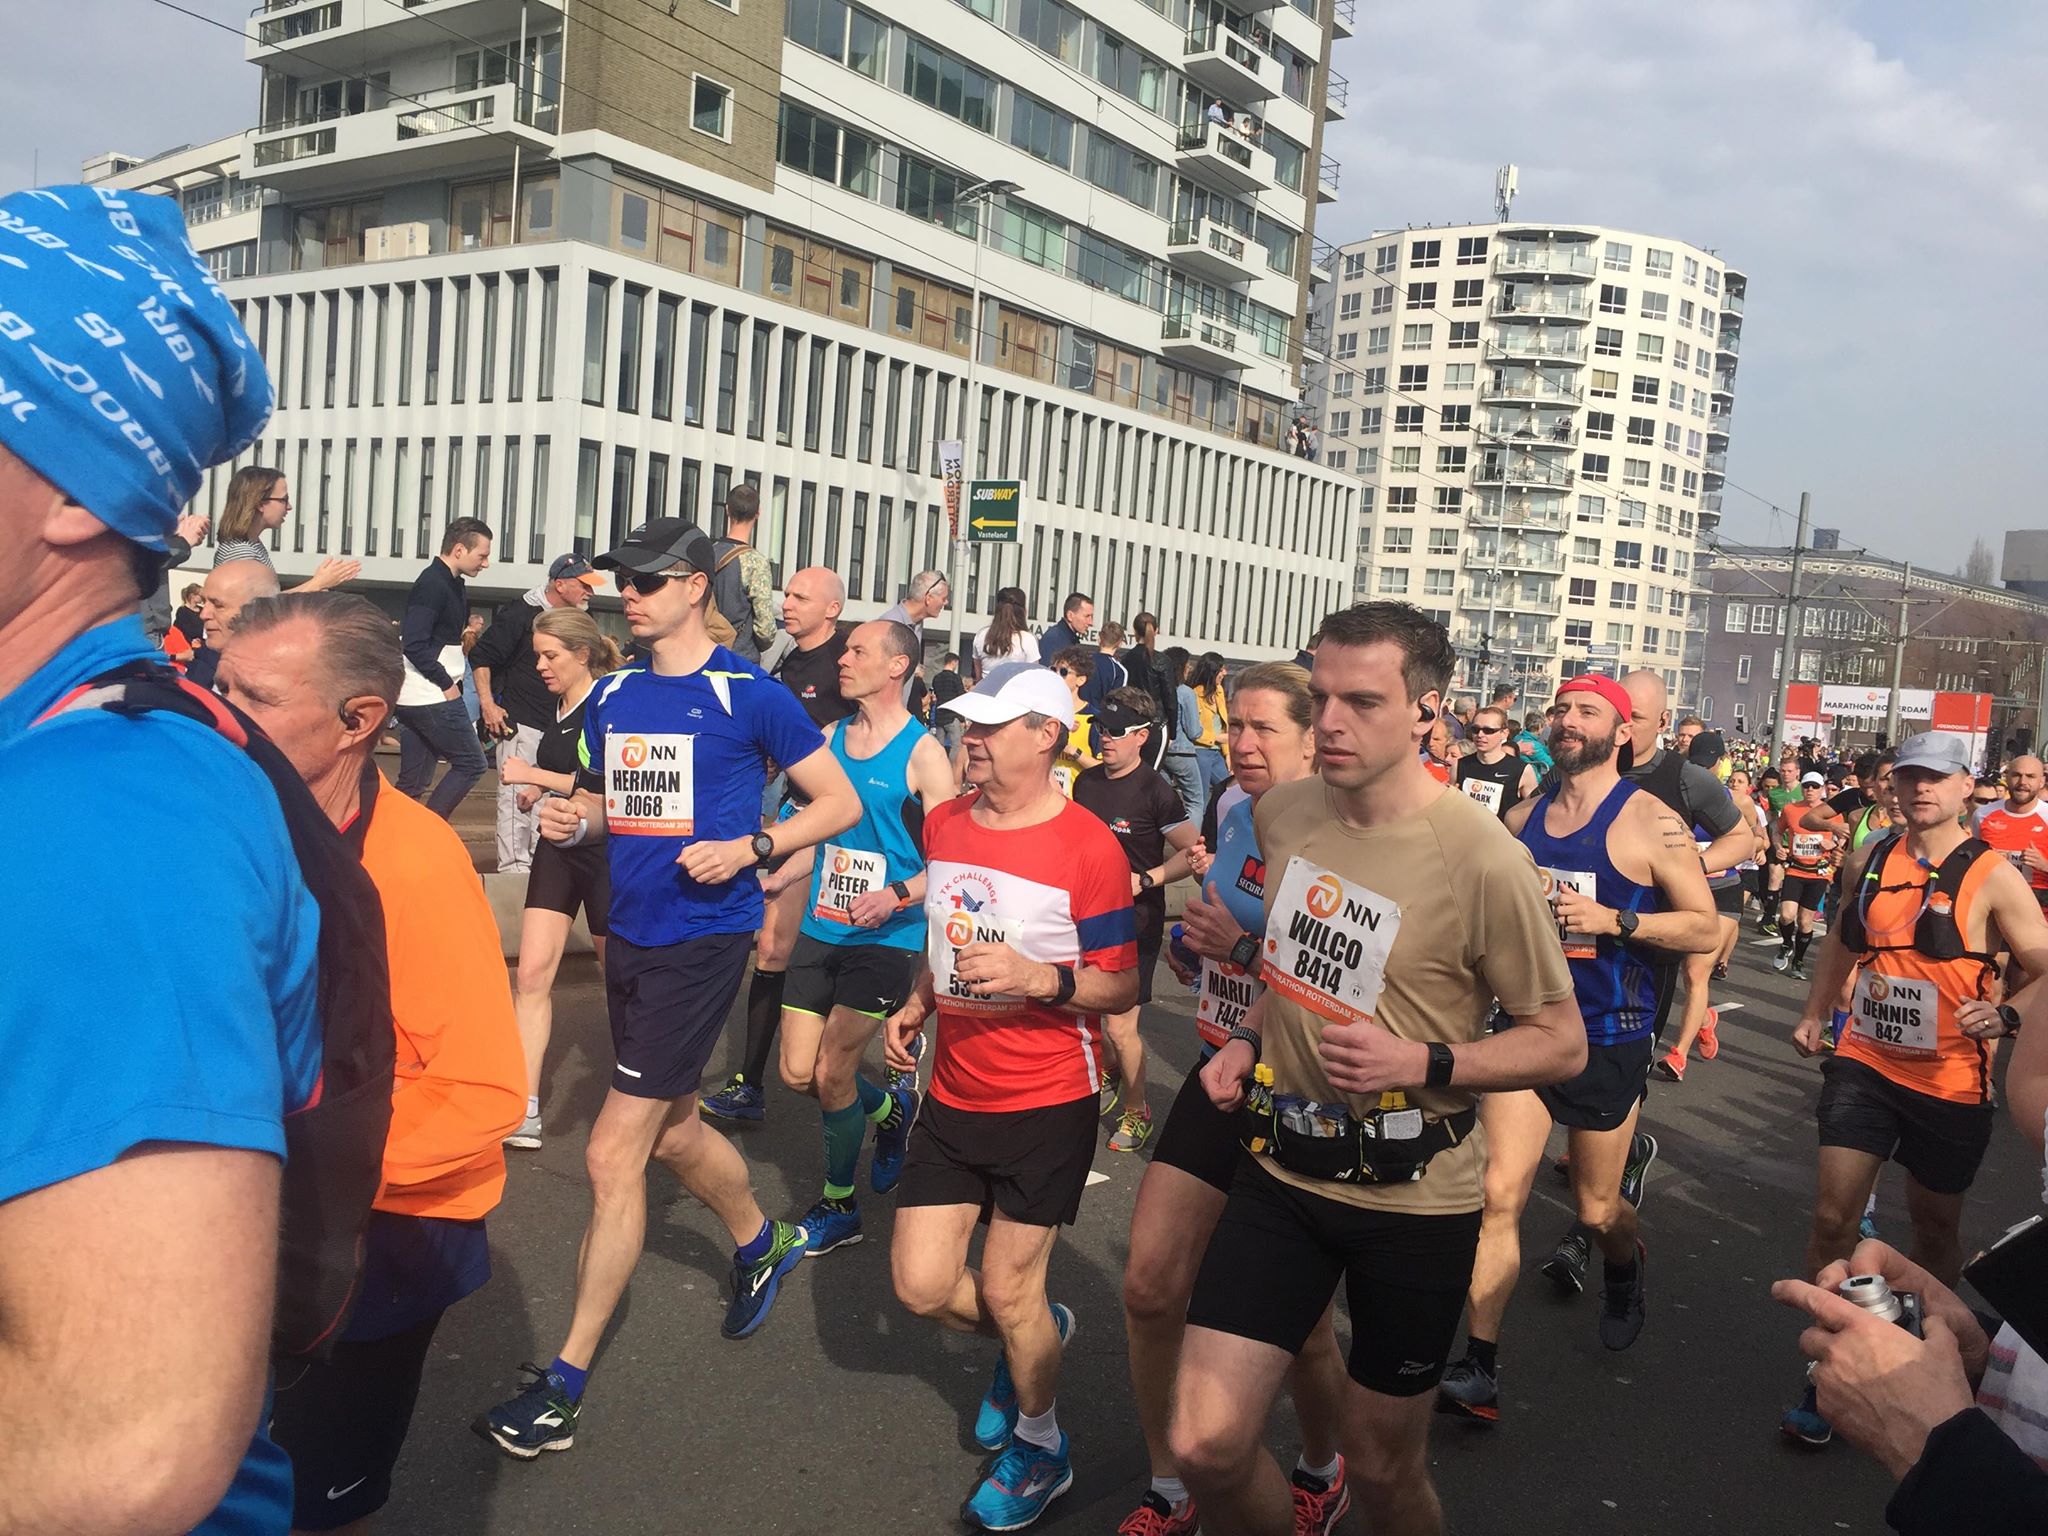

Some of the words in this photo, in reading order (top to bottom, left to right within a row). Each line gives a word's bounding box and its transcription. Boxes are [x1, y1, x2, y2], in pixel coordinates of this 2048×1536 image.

[973, 488, 1015, 500] SUBWAY
[978, 531, 1008, 539] Vasteland
[1824, 702, 1873, 711] MARATHON
[651, 746, 676, 760] NN
[613, 770, 680, 793] HERMAN
[625, 795, 662, 817] 8068
[1470, 792, 1491, 804] MARK
[1110, 823, 1132, 834] Vopak
[853, 859, 874, 872] NN
[828, 872, 869, 895] PIETER
[940, 882, 952, 895] TK
[953, 872, 997, 905] CHALLENGE
[1343, 898, 1381, 932] NN
[977, 926, 1005, 943] NN
[1288, 910, 1363, 970] WILCO
[1294, 949, 1343, 995] 8414
[1893, 986, 1921, 1001] NN
[965, 1001, 1008, 1012] ROTTERDAM
[1305, 988, 1351, 1020] ROTTERDAM
[1863, 997, 1921, 1027] DENNIS
[1876, 1022, 1903, 1044] 842
